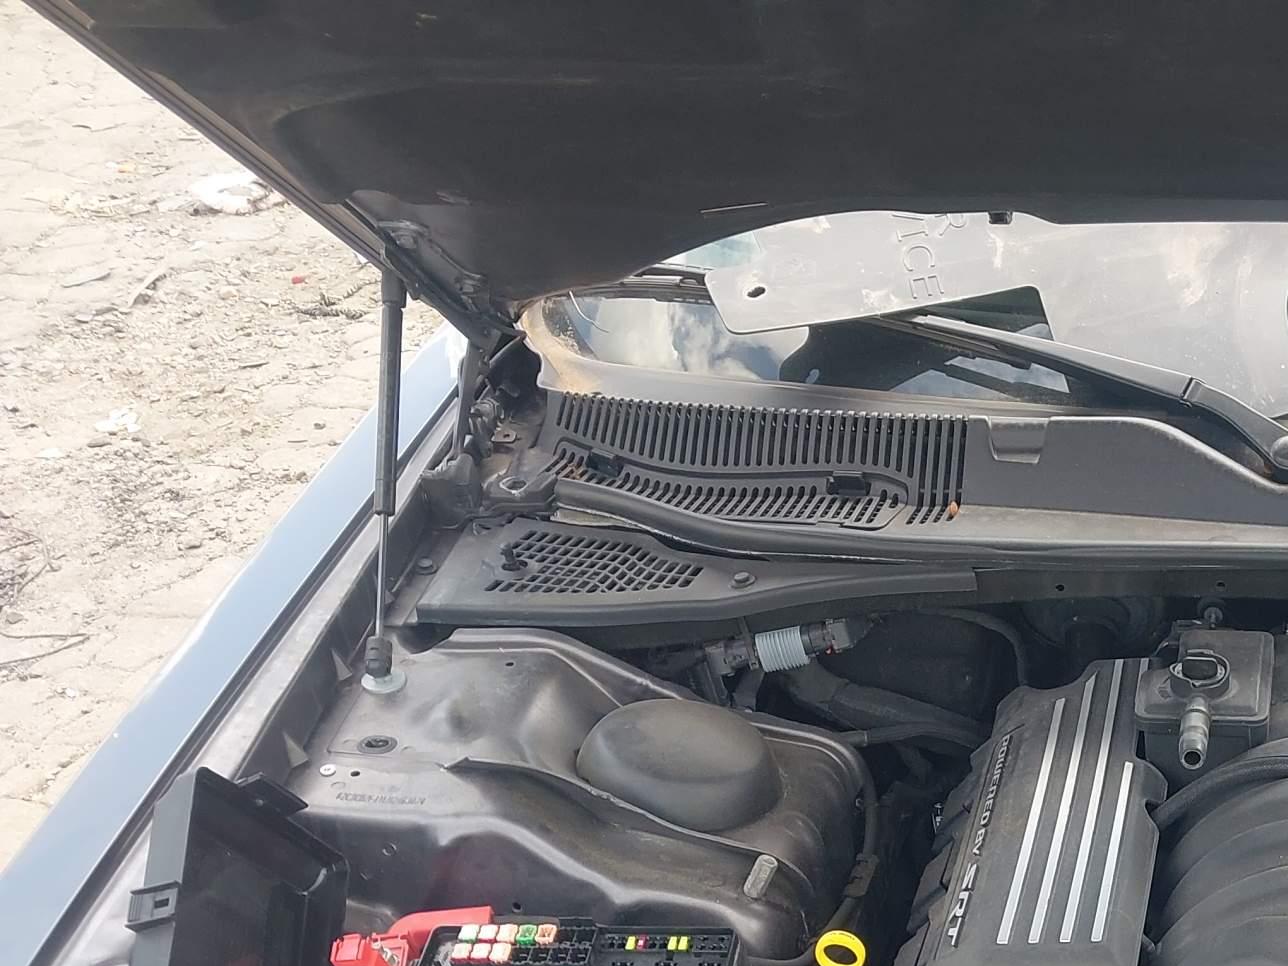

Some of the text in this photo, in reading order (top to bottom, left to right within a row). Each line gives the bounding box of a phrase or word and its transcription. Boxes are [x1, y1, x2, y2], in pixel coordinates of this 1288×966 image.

[947, 734, 1011, 946] POWERED BY SRT
